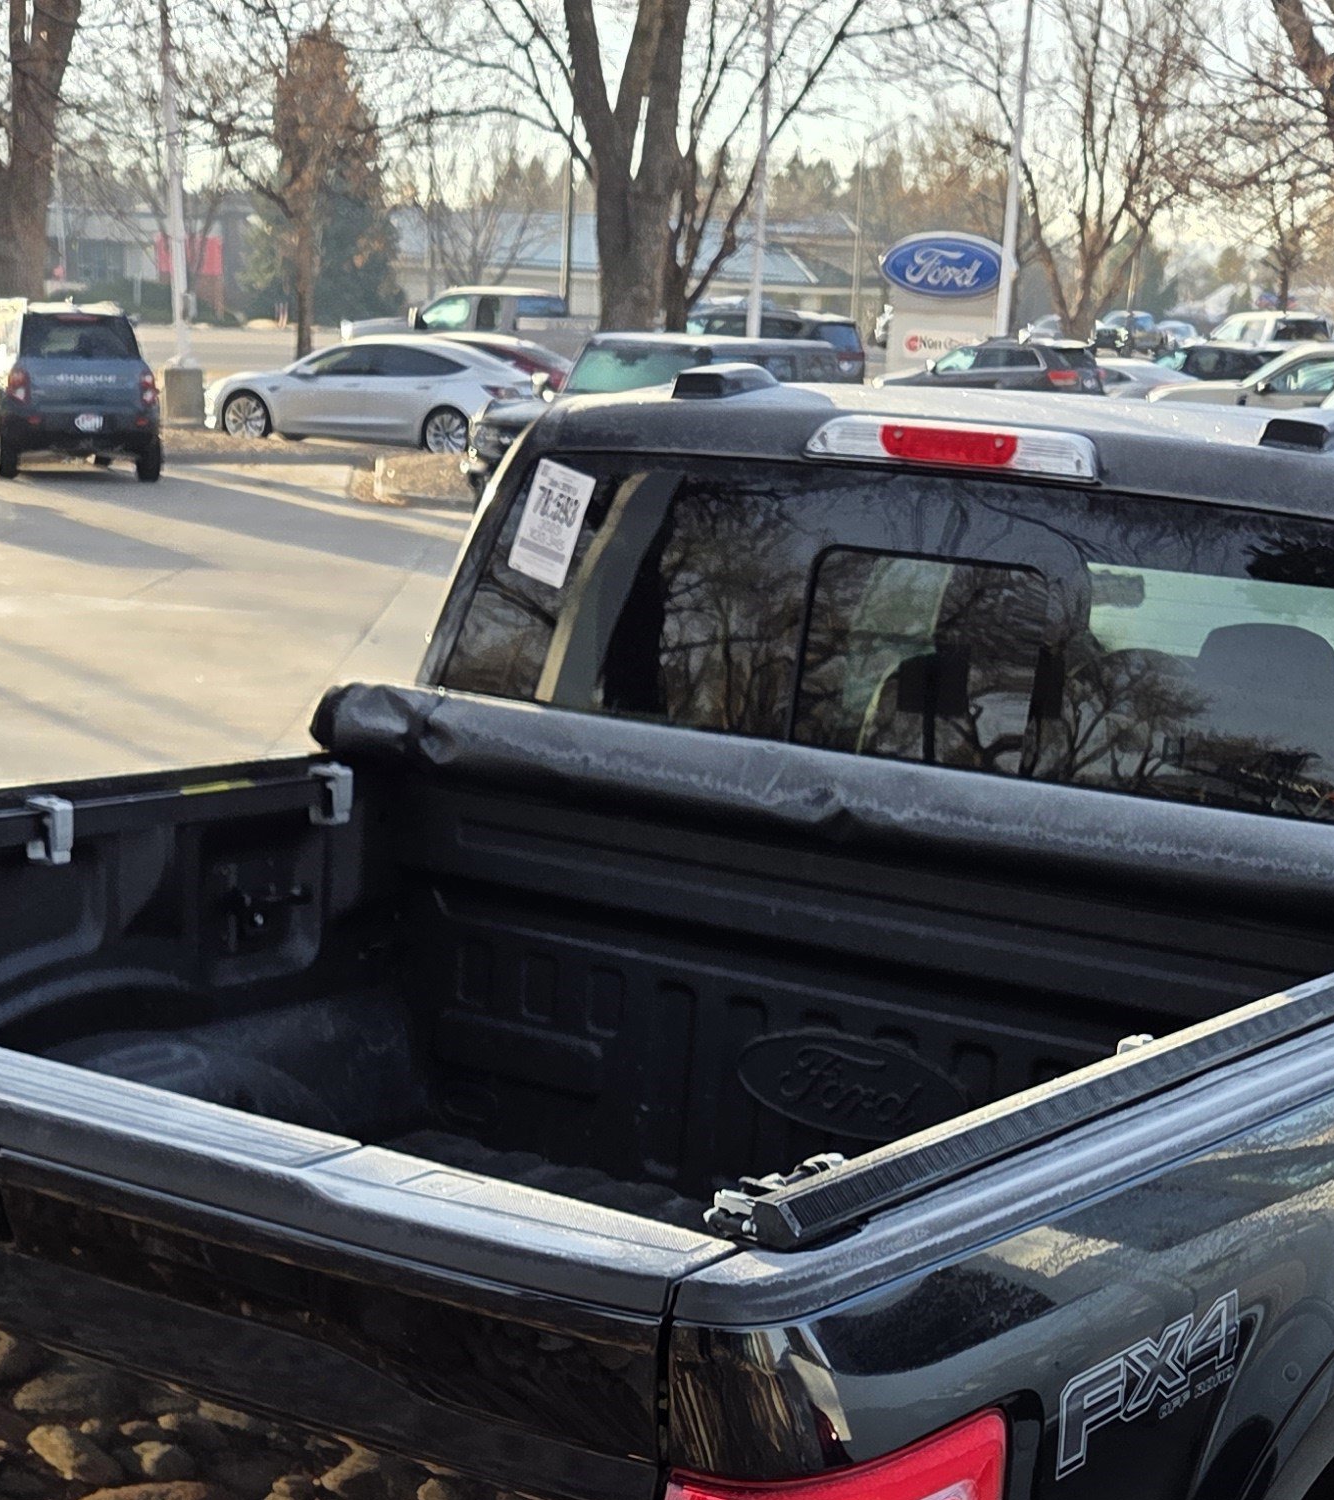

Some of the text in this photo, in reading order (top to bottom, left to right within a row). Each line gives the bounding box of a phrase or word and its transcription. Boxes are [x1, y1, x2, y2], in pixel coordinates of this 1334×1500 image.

[905, 247, 983, 288] Ford
[779, 1043, 923, 1125] Ford
[1055, 1288, 1241, 1480] FX4
